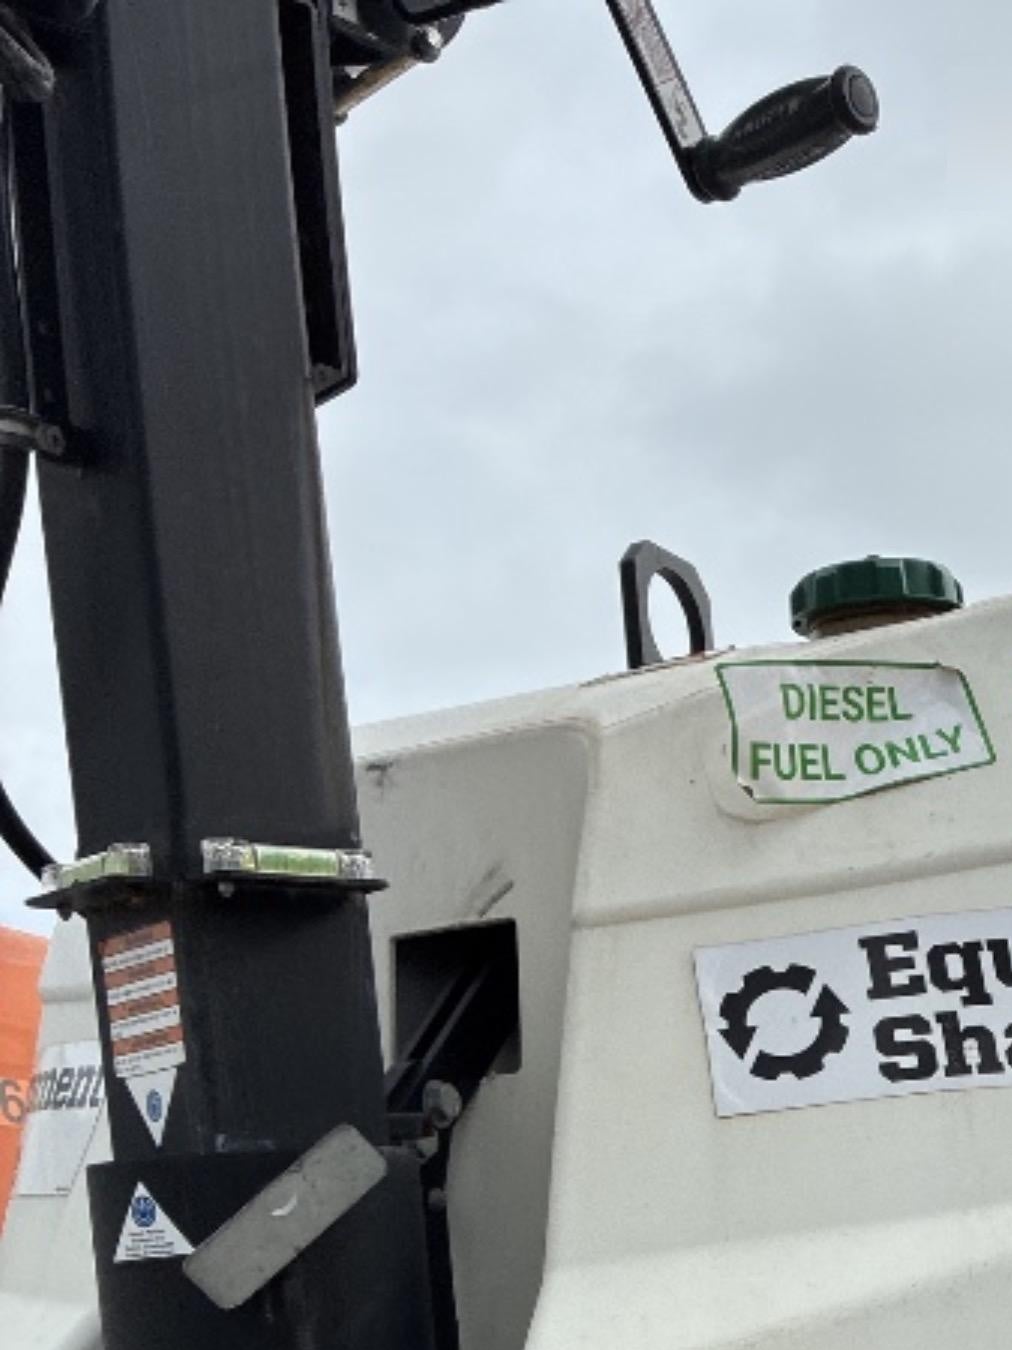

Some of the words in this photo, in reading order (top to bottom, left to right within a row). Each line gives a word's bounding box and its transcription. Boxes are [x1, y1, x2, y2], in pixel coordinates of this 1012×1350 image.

[780, 683, 914, 722] DIESEL
[750, 740, 847, 781] FUEL
[854, 723, 962, 775] ONLY
